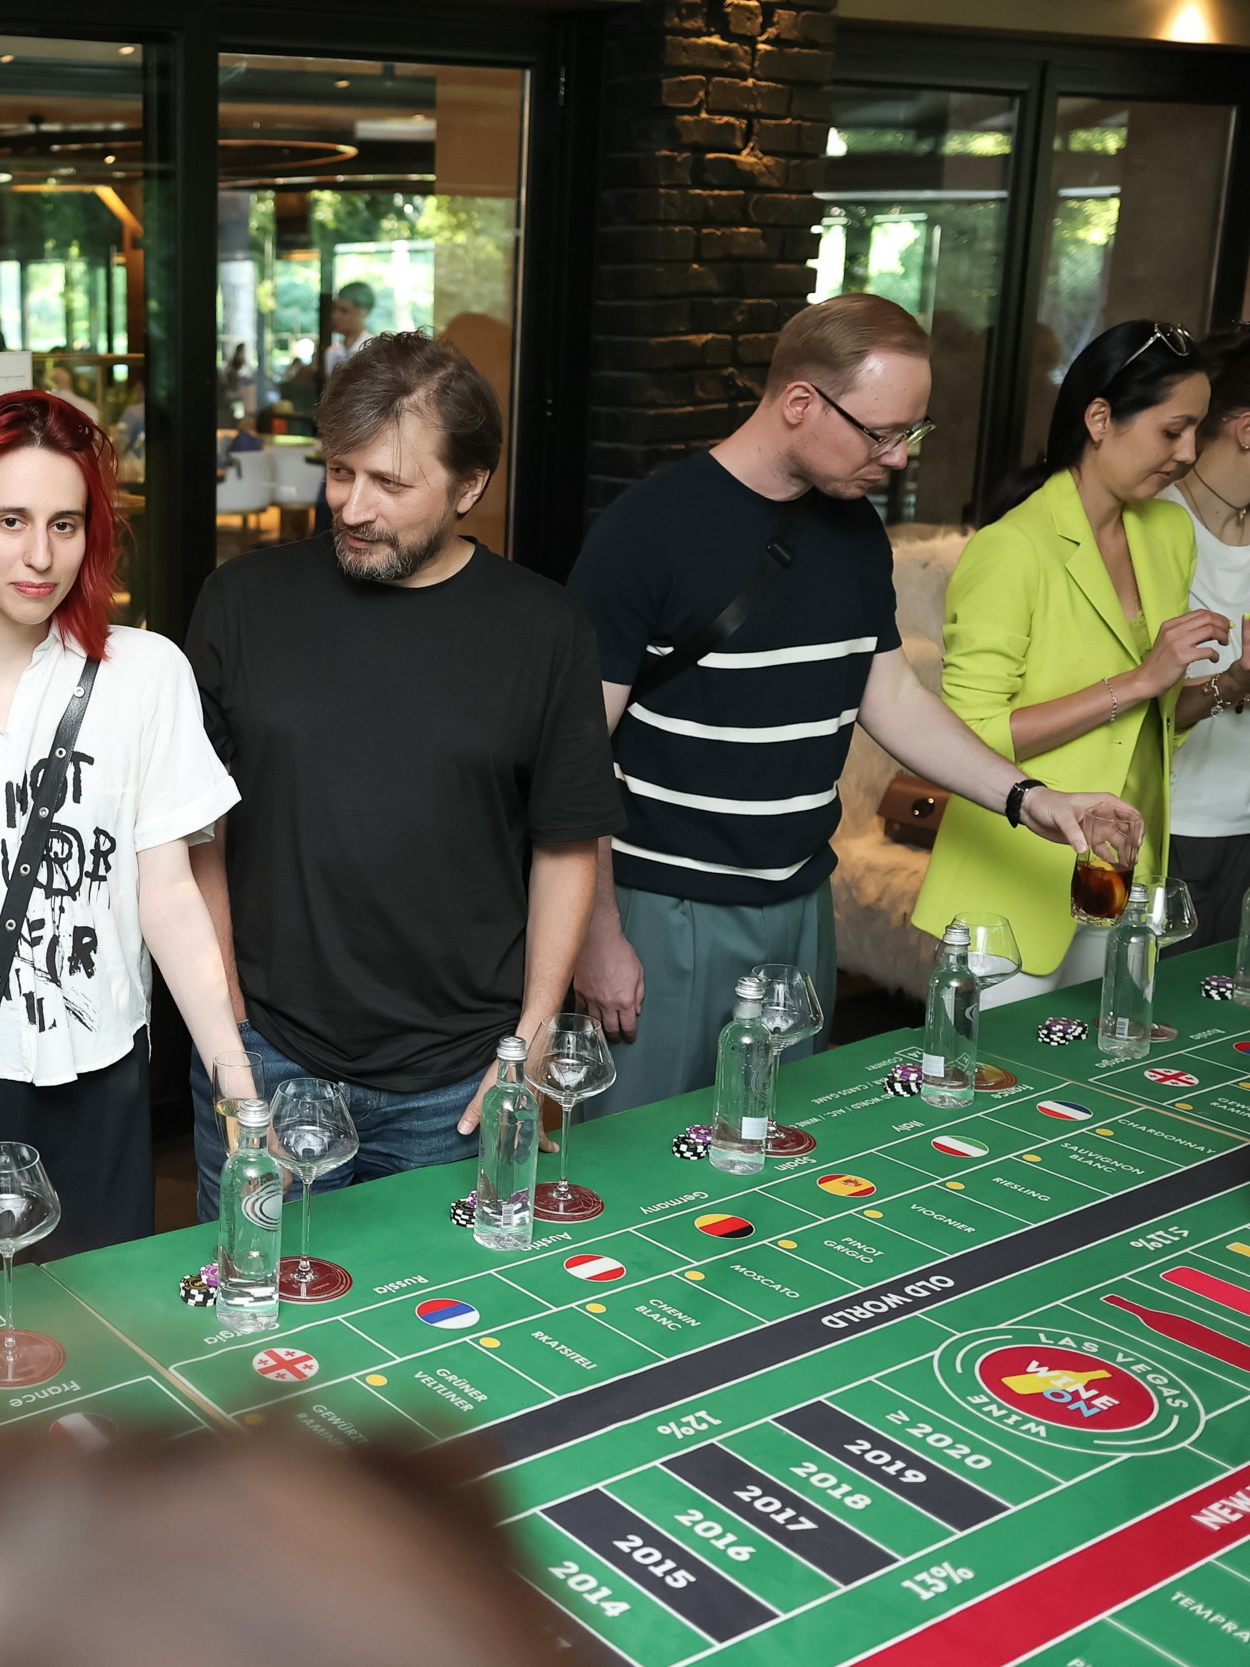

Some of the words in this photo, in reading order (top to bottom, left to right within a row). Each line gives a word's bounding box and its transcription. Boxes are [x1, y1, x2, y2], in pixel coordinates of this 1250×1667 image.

[991, 1084, 1034, 1099] France
[891, 1120, 925, 1133] Italy
[1118, 1118, 1217, 1154] CHARDONNAY
[773, 1155, 816, 1172] Spain
[1060, 1142, 1145, 1175] SAUVIGNON
[1069, 1154, 1117, 1173] BLANC
[639, 1190, 709, 1215] Germany
[992, 1177, 1051, 1202] RIESLING
[910, 1203, 975, 1233] VIOGNIER
[823, 1240, 874, 1264] GRIGIO
[842, 1237, 884, 1257] PINOT
[372, 1275, 429, 1295] Russia
[729, 1264, 800, 1299] MOSCATO
[904, 1275, 955, 1298] OLD
[634, 1304, 682, 1332] BLANC
[649, 1298, 701, 1328] CHENIN
[821, 1292, 914, 1329] WORLD
[203, 1322, 280, 1345] Grgia
[531, 1330, 597, 1371] RKATSITELI
[436, 1368, 489, 1403] GRÜNER
[1025, 1360, 1120, 1410] WINE
[1038, 1333, 1100, 1353] LAS
[1115, 1353, 1189, 1409] VEGAS
[9, 1380, 82, 1407] France
[414, 1370, 474, 1412] VELTLINER
[1042, 1387, 1103, 1418] ON
[657, 1410, 723, 1439] 12%
[966, 1393, 1047, 1438] WINE
[843, 1439, 927, 1483] 2019
[905, 1423, 992, 1470] 2020
[789, 1462, 872, 1510] 2018
[733, 1485, 818, 1534] 2017
[673, 1509, 757, 1562] 2016
[612, 1534, 697, 1589] 2015
[548, 1560, 632, 1618] 2014
[901, 1561, 975, 1600] 13%
